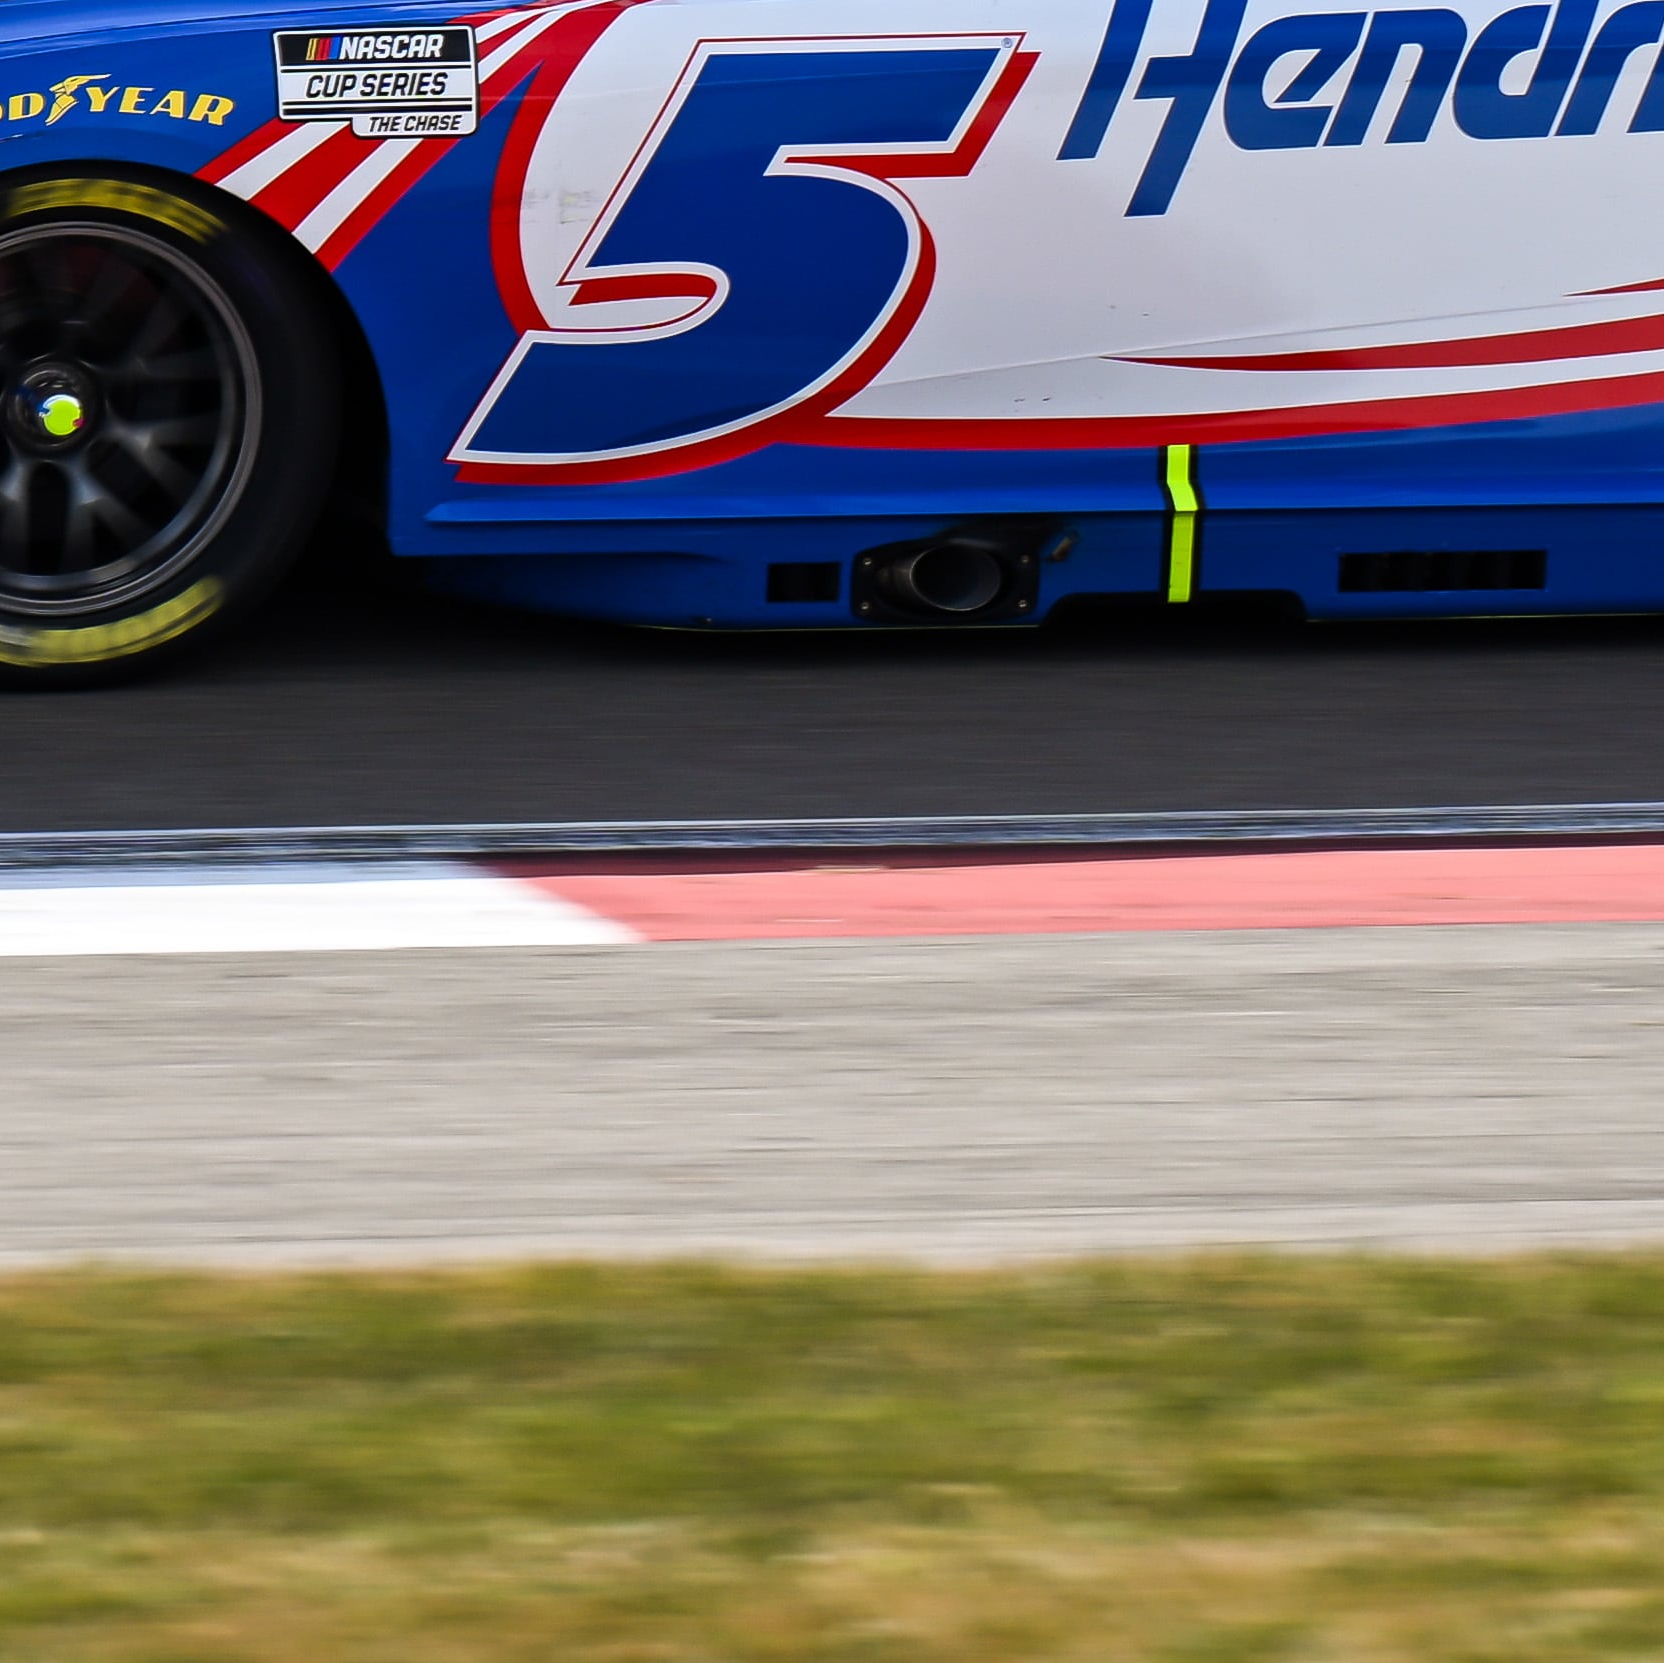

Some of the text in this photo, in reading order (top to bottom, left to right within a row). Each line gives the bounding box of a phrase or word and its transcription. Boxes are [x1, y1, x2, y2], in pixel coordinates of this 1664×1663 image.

[339, 33, 445, 61] NASCAR
[305, 71, 449, 99] CUP SERIES
[369, 114, 463, 133] THE CHASE
[445, 33, 1040, 484] 5
